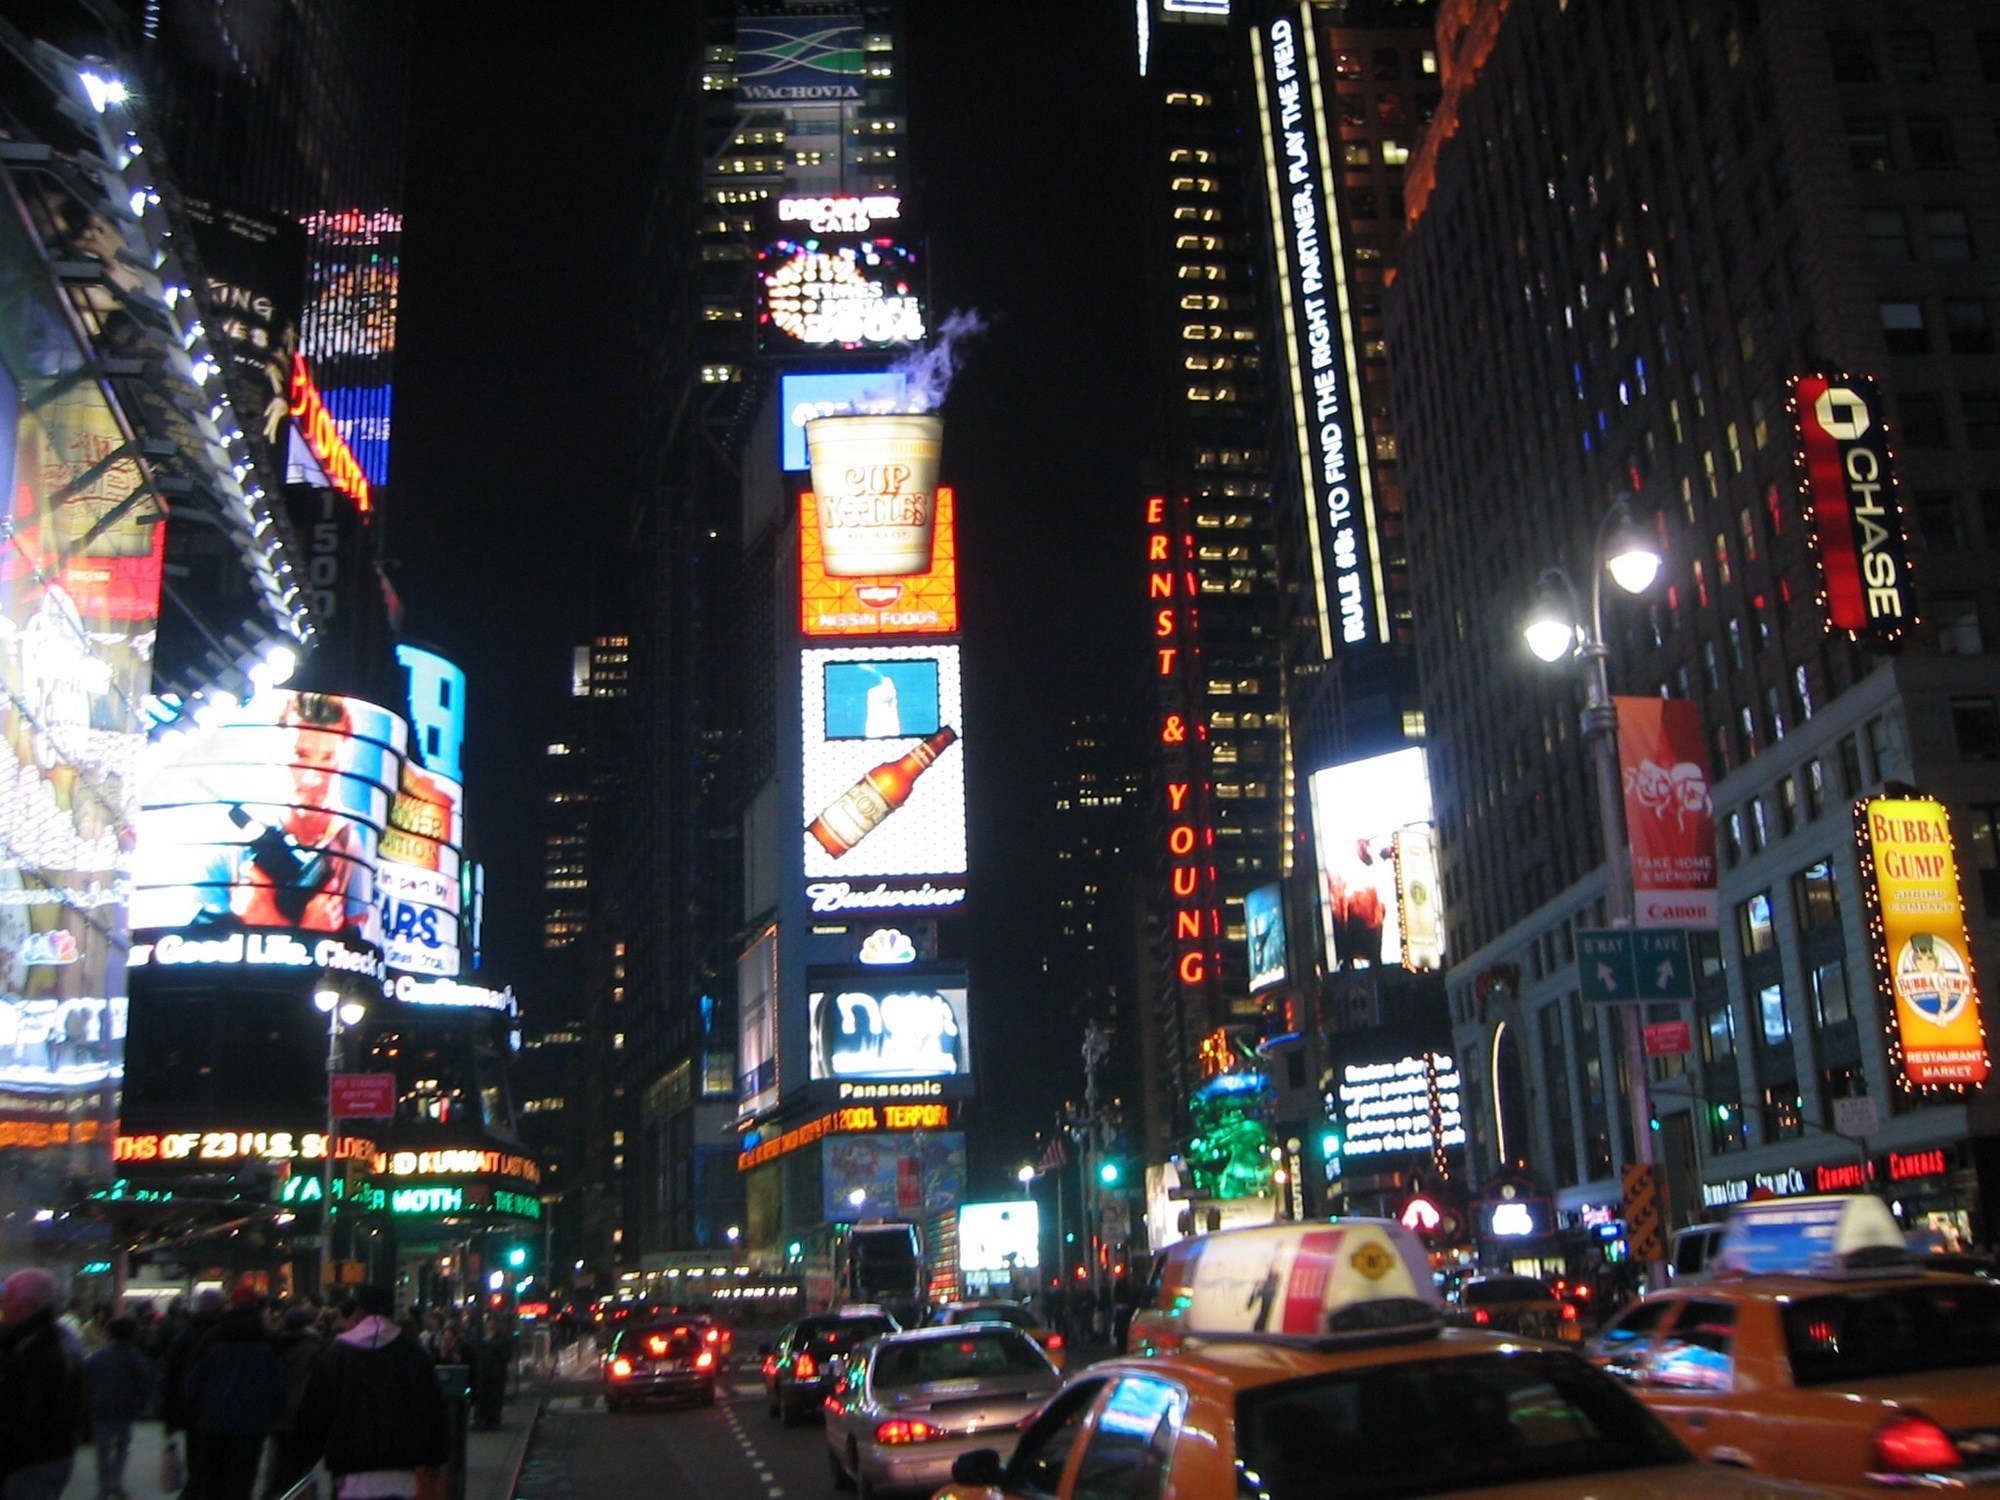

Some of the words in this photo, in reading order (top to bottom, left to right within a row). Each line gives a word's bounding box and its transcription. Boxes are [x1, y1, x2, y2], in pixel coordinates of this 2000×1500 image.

[1271, 19, 1297, 82] FIELD
[742, 85, 859, 100] WACHOVIA
[1278, 79, 1302, 130] THE
[1284, 131, 1310, 184] PLAY
[778, 197, 901, 221] DISCOVER
[810, 218, 871, 233] CARD
[1292, 183, 1324, 294] PARTNER,
[809, 282, 883, 299] TIMES
[1304, 298, 1334, 369] RIGHT
[1314, 369, 1339, 422] THE
[1321, 422, 1347, 484] FIND
[844, 464, 911, 498] CUP
[1327, 486, 1351, 528] TO
[1847, 448, 1902, 619] CHASE
[1146, 497, 1177, 676] ERNST
[819, 612, 877, 627] NISSIN
[880, 610, 939, 625] FOODS
[1341, 571, 1366, 643] RULE
[1162, 715, 1186, 743] &
[1873, 814, 1946, 844] BUBBA
[1637, 857, 1671, 869] TAKE
[1674, 857, 1712, 869] HOME
[1655, 871, 1710, 882] MEMORY
[1884, 850, 1944, 880] GUMP
[806, 882, 966, 913] Budweiser
[1168, 783, 1204, 983] YOUNG
[1647, 903, 1707, 919] Canon
[1899, 976, 1936, 993] BUBBA
[1907, 1050, 1982, 1064] RESTAURANT
[1922, 1065, 1972, 1078] MARKET
[839, 1081, 942, 1099] Panasonic
[161, 1133, 201, 1159] OF
[419, 1149, 500, 1175] KUWAIT
[1889, 1149, 1946, 1181] CAMERAS
